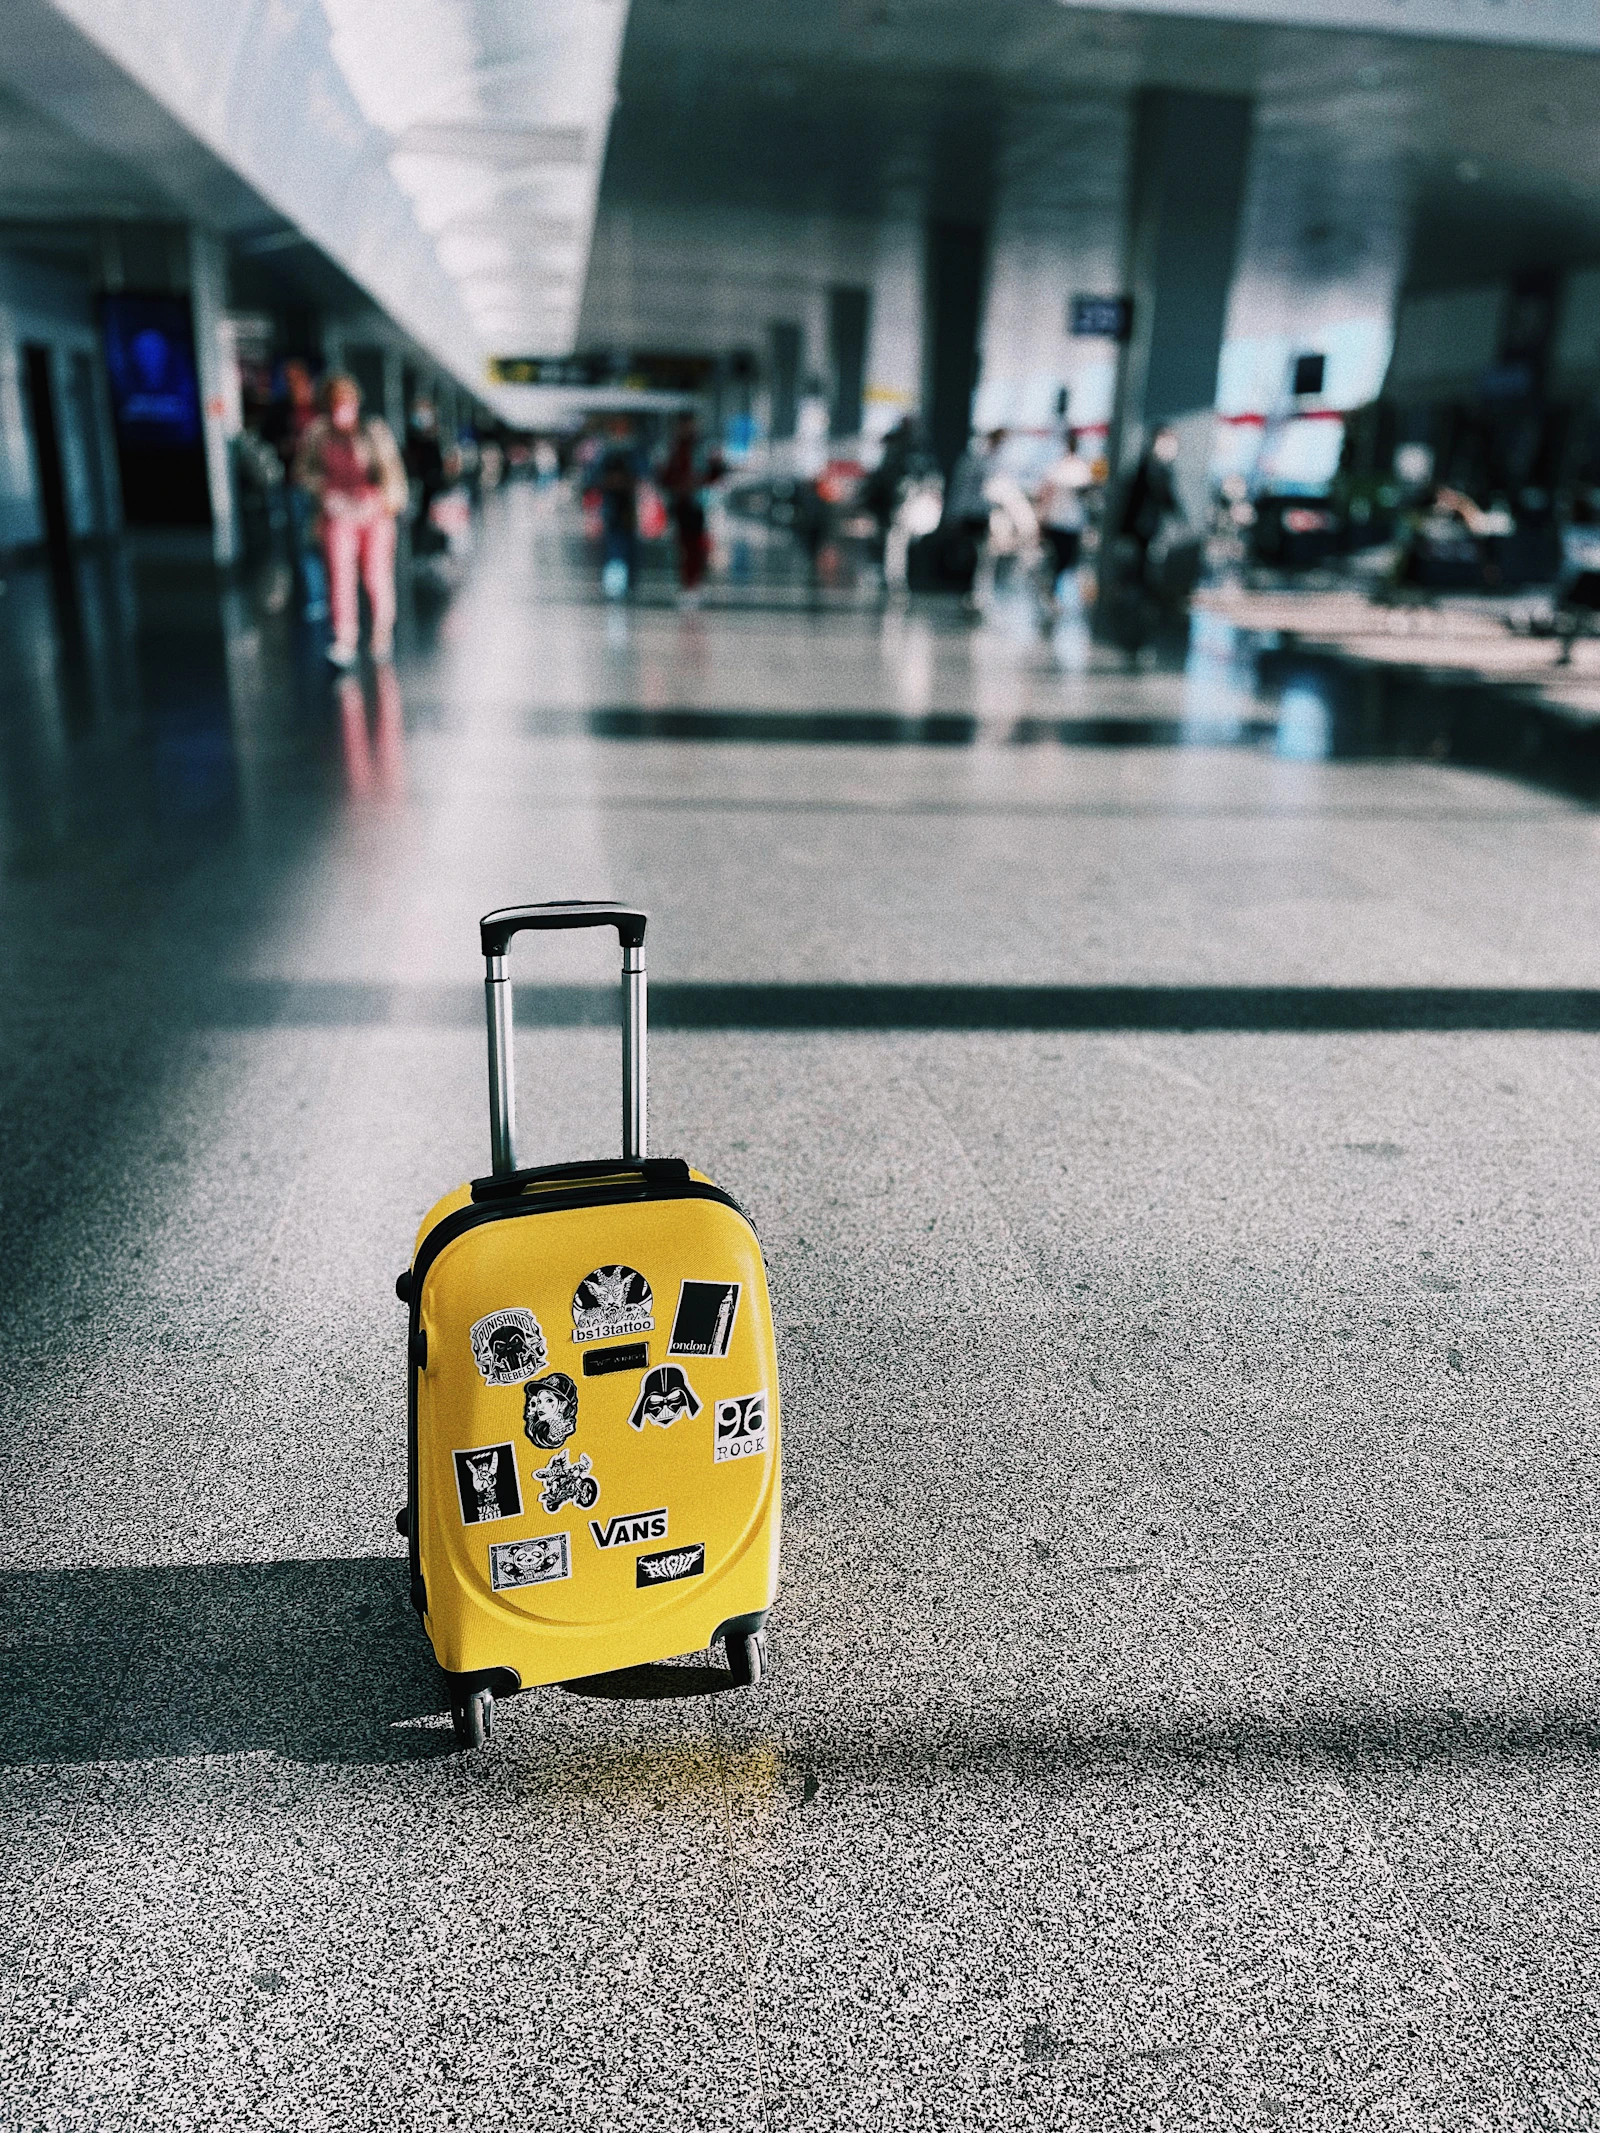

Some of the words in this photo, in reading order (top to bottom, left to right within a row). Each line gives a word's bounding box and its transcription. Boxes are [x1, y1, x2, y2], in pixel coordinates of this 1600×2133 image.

[479, 1313, 530, 1347] PUNISHING
[577, 1320, 651, 1341] bs13tattoo
[671, 1339, 707, 1351] ondon
[501, 1364, 532, 1381] REBELS
[718, 1394, 766, 1440] 96
[716, 1437, 765, 1461] ROCK
[590, 1508, 667, 1548] VANS
